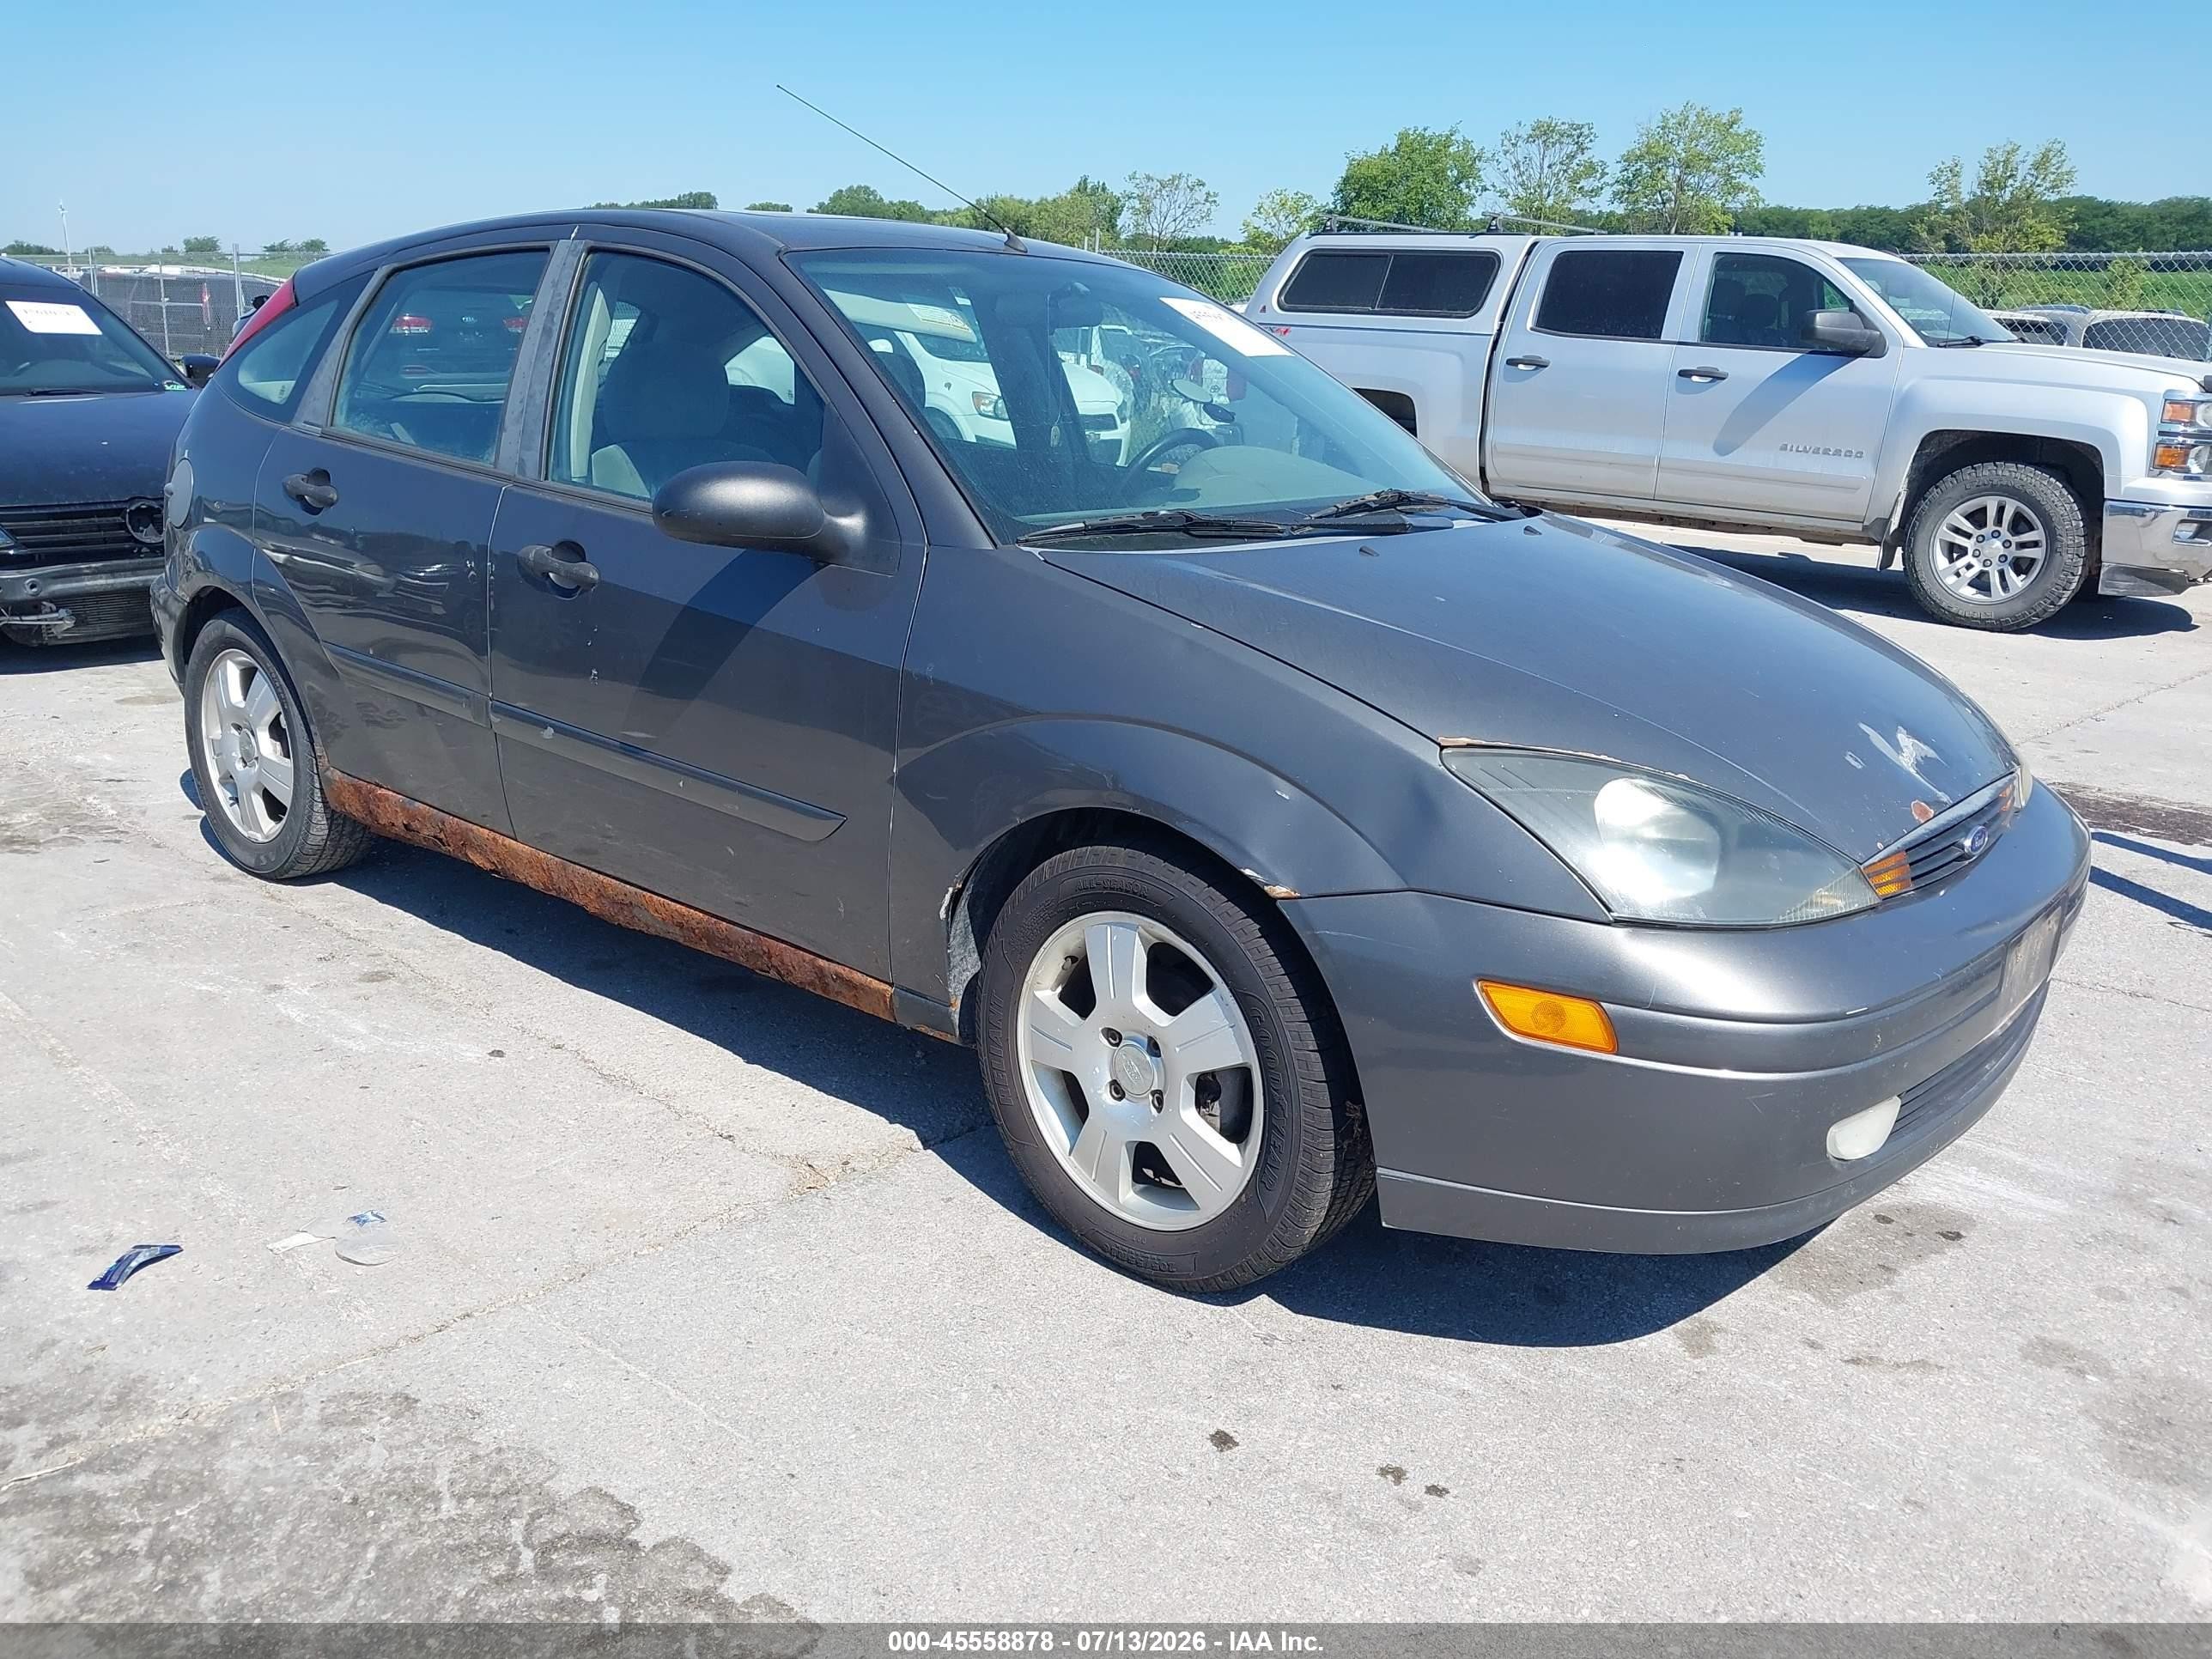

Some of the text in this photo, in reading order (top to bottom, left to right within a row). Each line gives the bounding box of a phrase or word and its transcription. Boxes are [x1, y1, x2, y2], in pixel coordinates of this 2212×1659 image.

[1778, 443, 1864, 459] SILVERADO
[1075, 878, 1148, 897] ALL-SEASON
[988, 990, 1014, 1106] RELIANT
[1250, 1007, 1288, 1191] GOODYEAR
